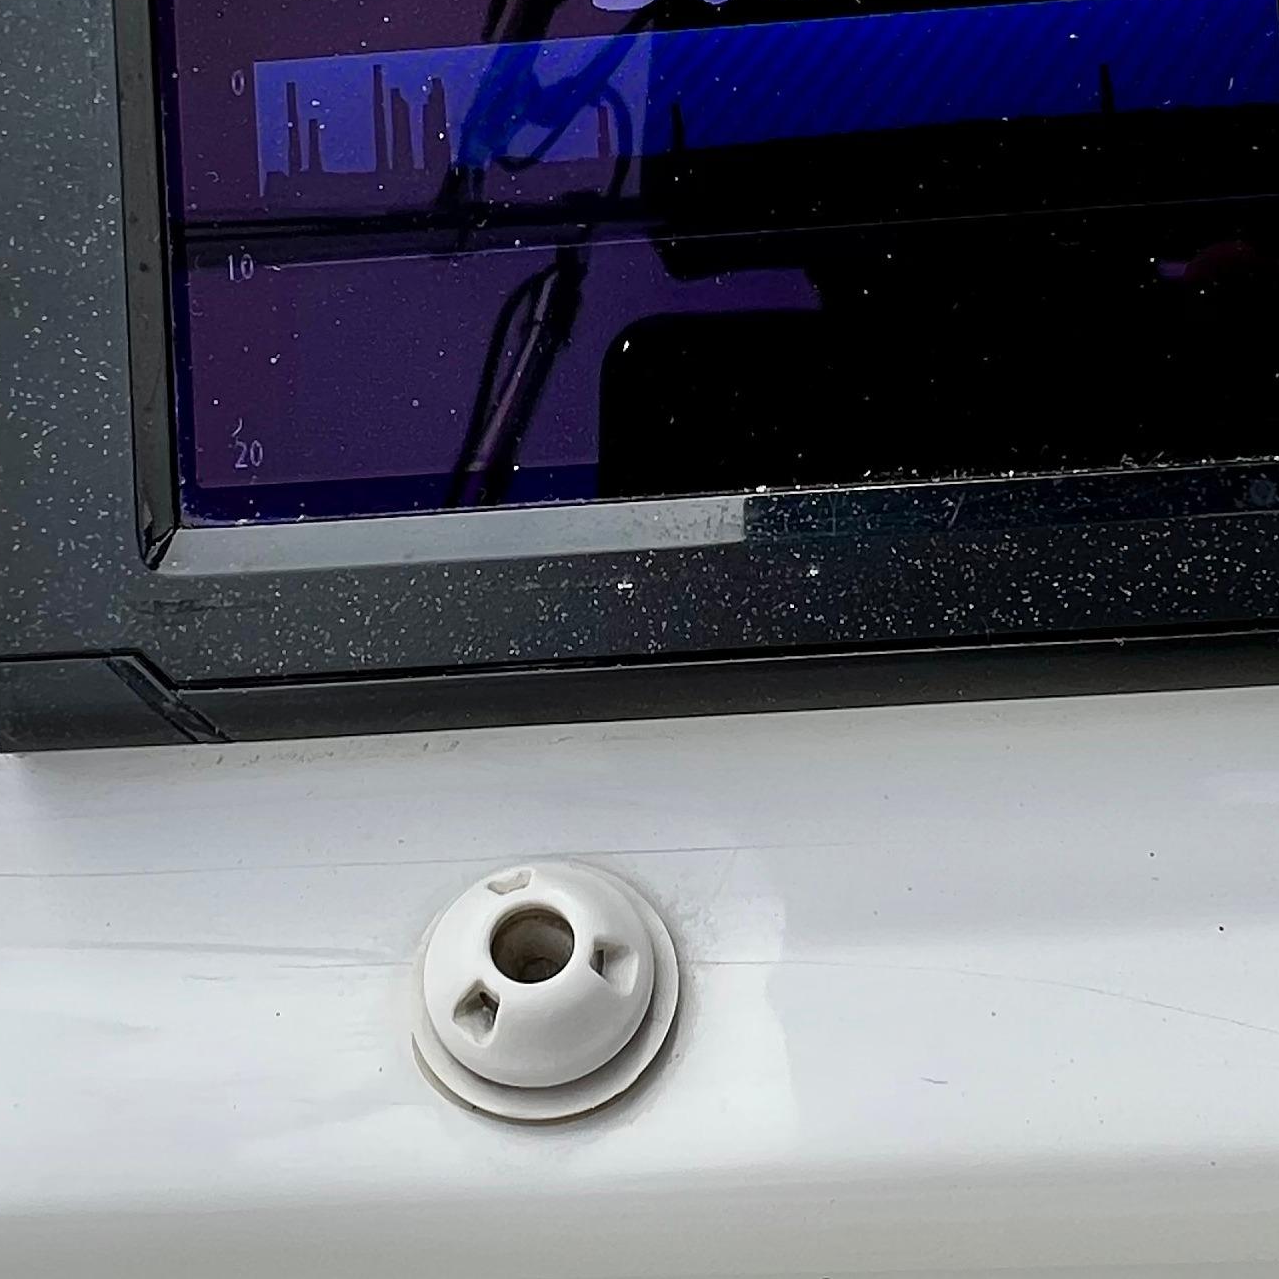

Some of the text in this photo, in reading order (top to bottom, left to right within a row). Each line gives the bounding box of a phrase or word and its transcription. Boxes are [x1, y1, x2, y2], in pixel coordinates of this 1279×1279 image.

[231, 68, 246, 97] 0
[227, 252, 255, 283] 10
[234, 439, 264, 470] 20
